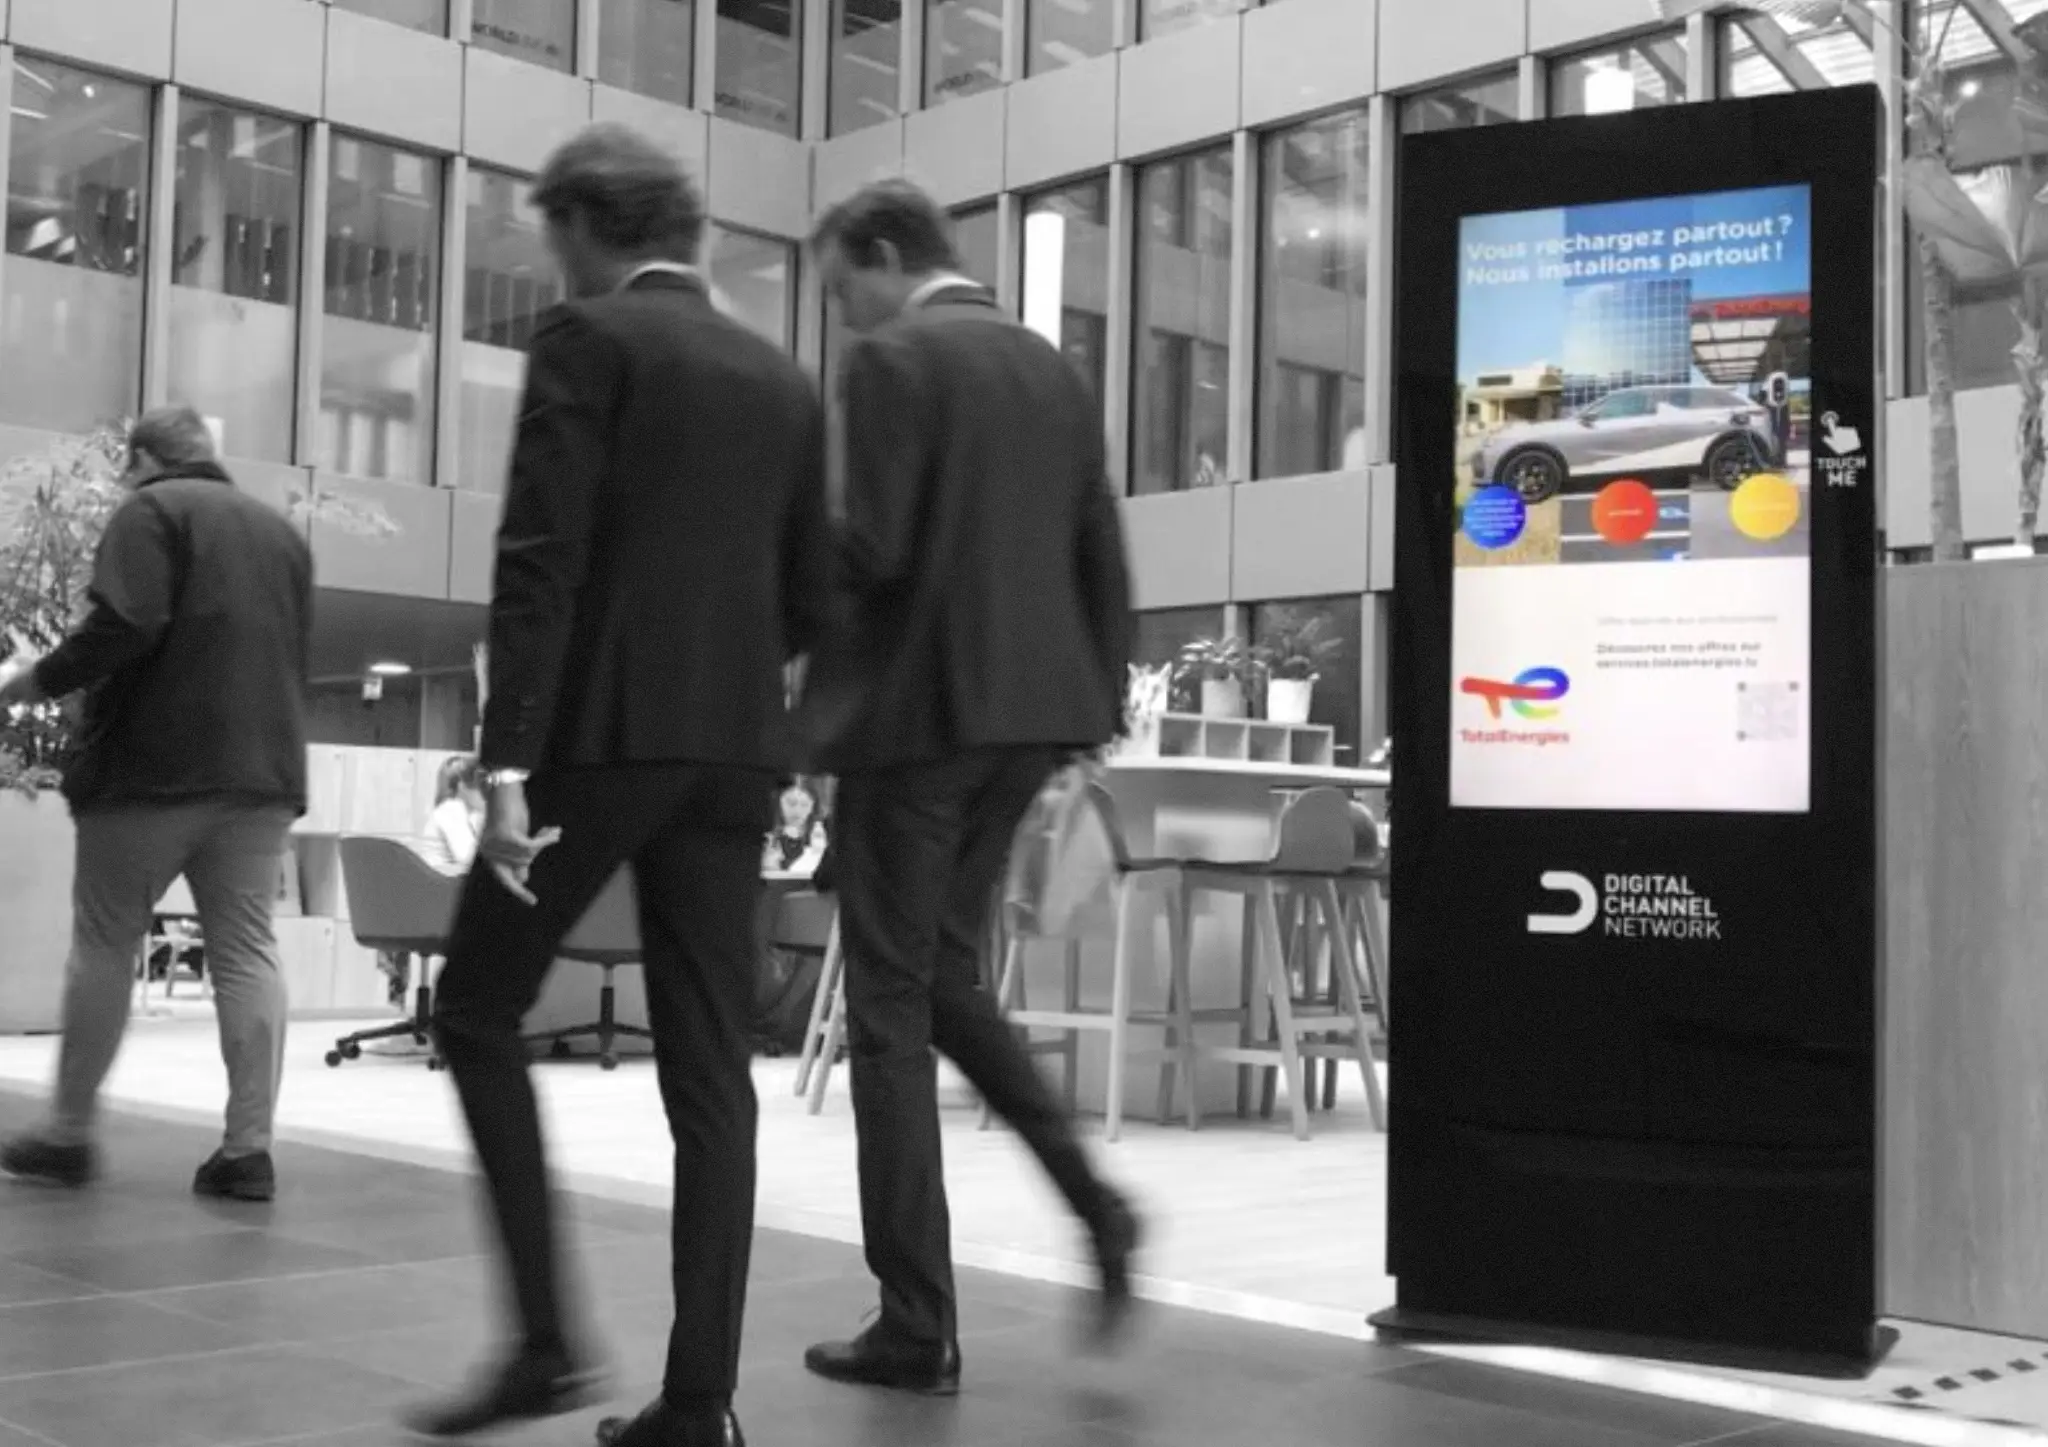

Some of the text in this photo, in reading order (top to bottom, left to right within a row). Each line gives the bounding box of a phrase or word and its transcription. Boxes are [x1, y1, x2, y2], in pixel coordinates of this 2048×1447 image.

[1536, 229, 1665, 256] rechargez
[1467, 265, 1530, 286] Nous
[1538, 253, 1662, 281] installons
[1815, 456, 1866, 471] TOUCH
[1828, 469, 1857, 487] ME
[1604, 873, 1696, 896] DIGITAL
[1604, 896, 1719, 918] CHANNEL
[1604, 917, 1722, 940] NETWORK
